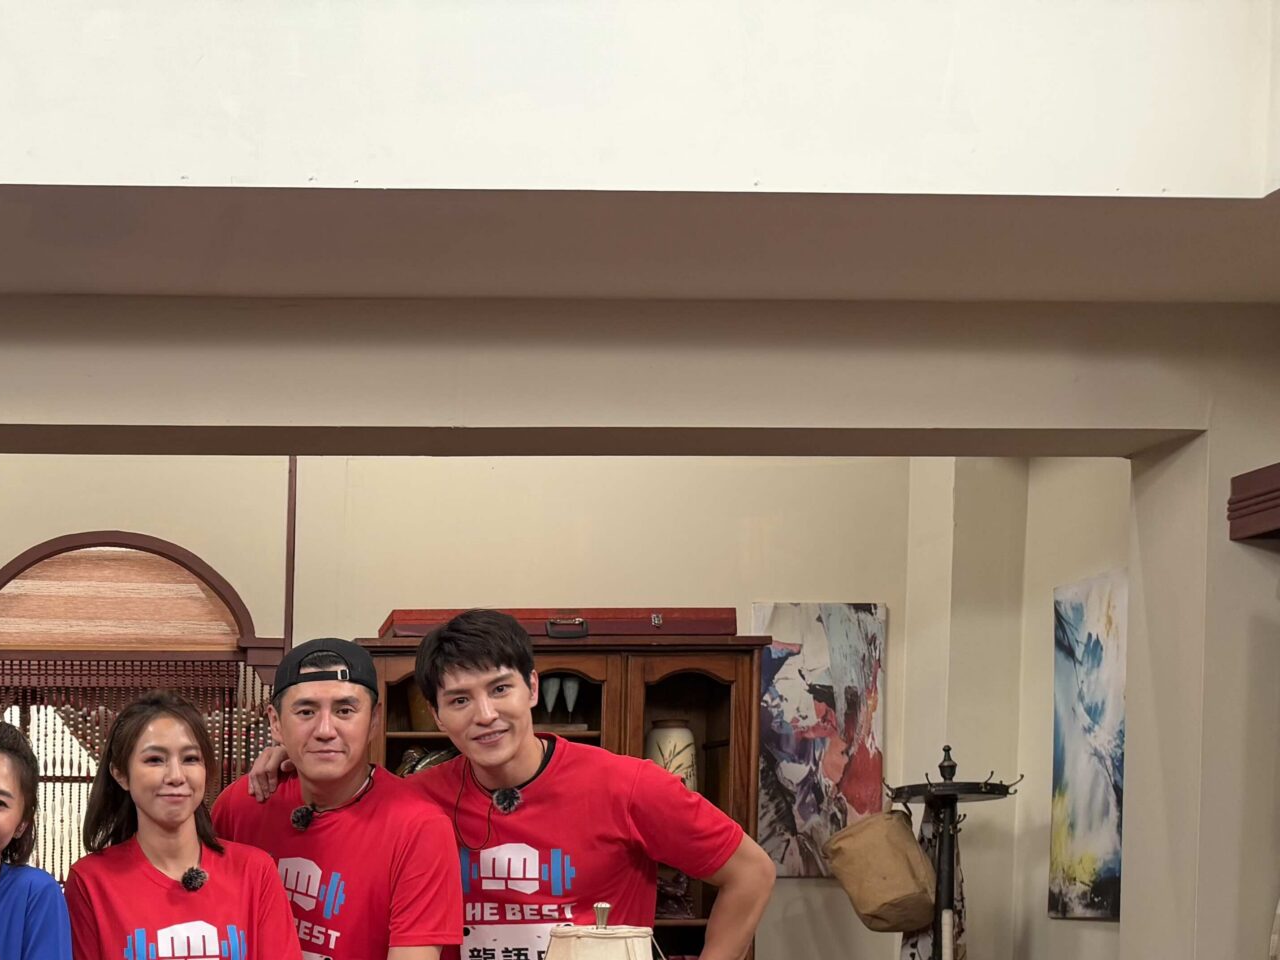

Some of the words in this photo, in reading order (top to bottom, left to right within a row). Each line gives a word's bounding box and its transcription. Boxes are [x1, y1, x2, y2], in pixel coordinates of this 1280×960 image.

[466, 902, 499, 921] HE
[505, 903, 577, 920] BEST
[293, 918, 341, 949] EST
